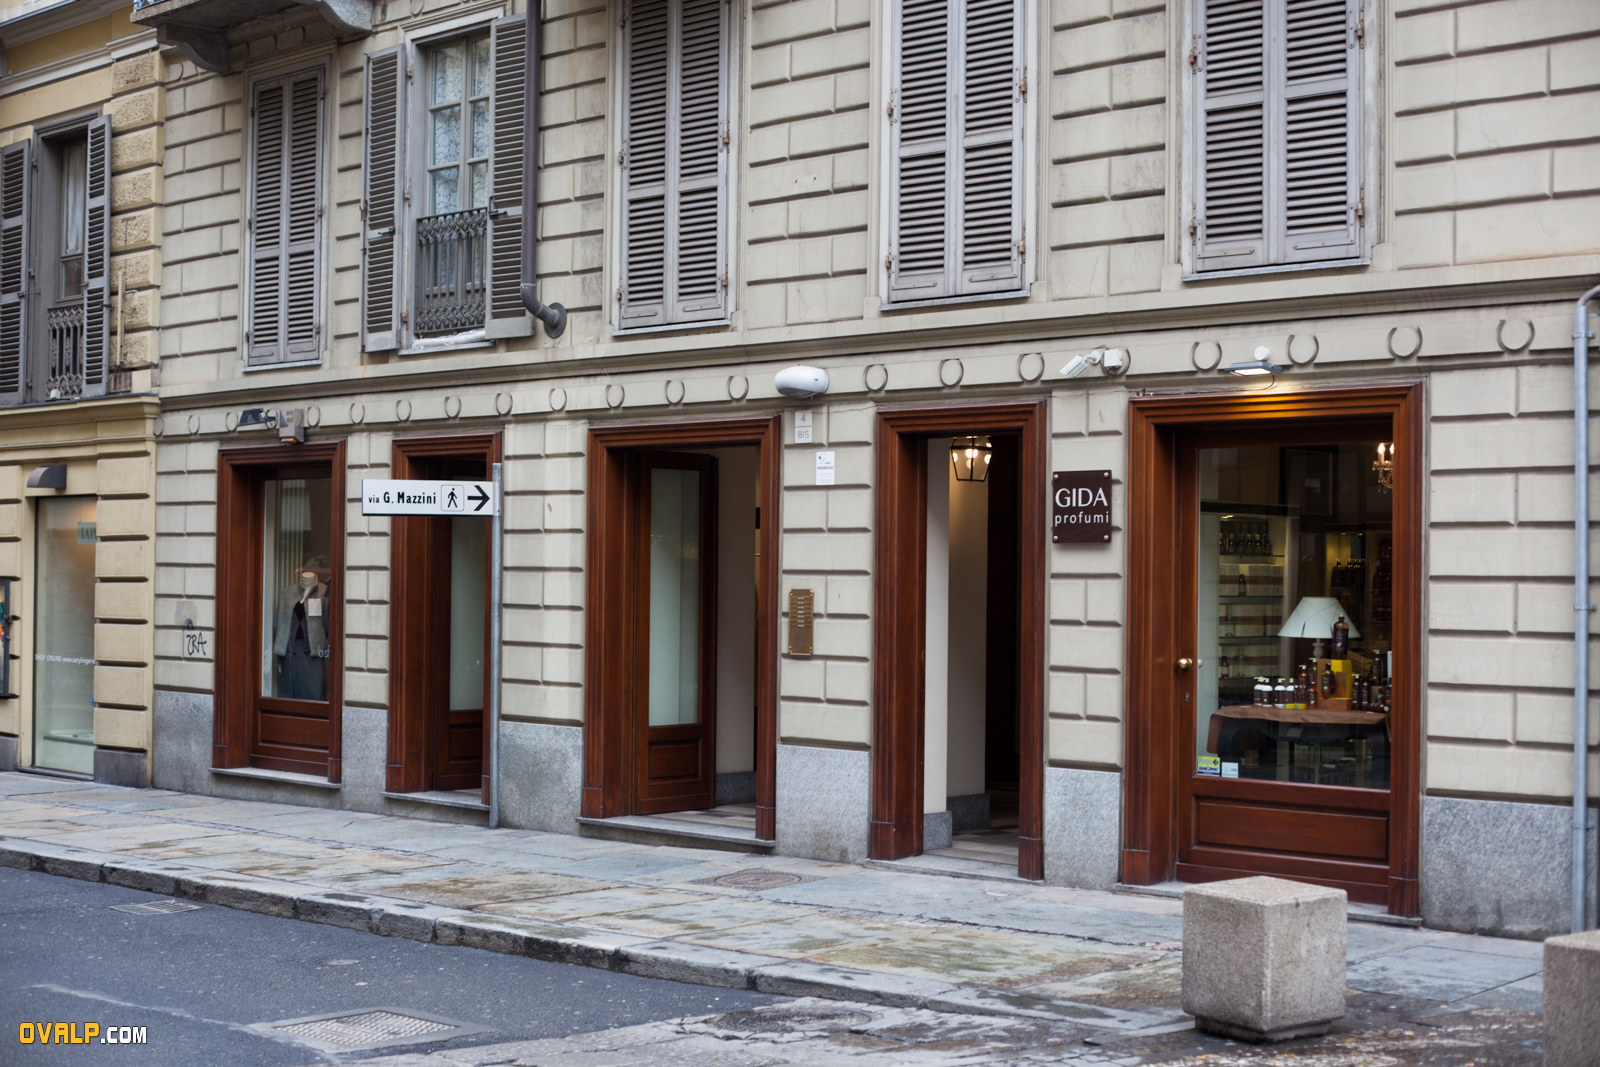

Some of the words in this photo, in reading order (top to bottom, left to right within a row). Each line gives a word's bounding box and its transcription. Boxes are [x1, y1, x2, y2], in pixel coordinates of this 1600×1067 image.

[801, 414, 806, 422] 4
[798, 430, 809, 439] BIS
[368, 494, 380, 503] via
[383, 491, 394, 504] G.
[397, 491, 436, 504] Mazzini
[1055, 487, 1108, 508] GIDA
[1054, 510, 1109, 528] profumi
[46, 654, 62, 662] ONLINE
